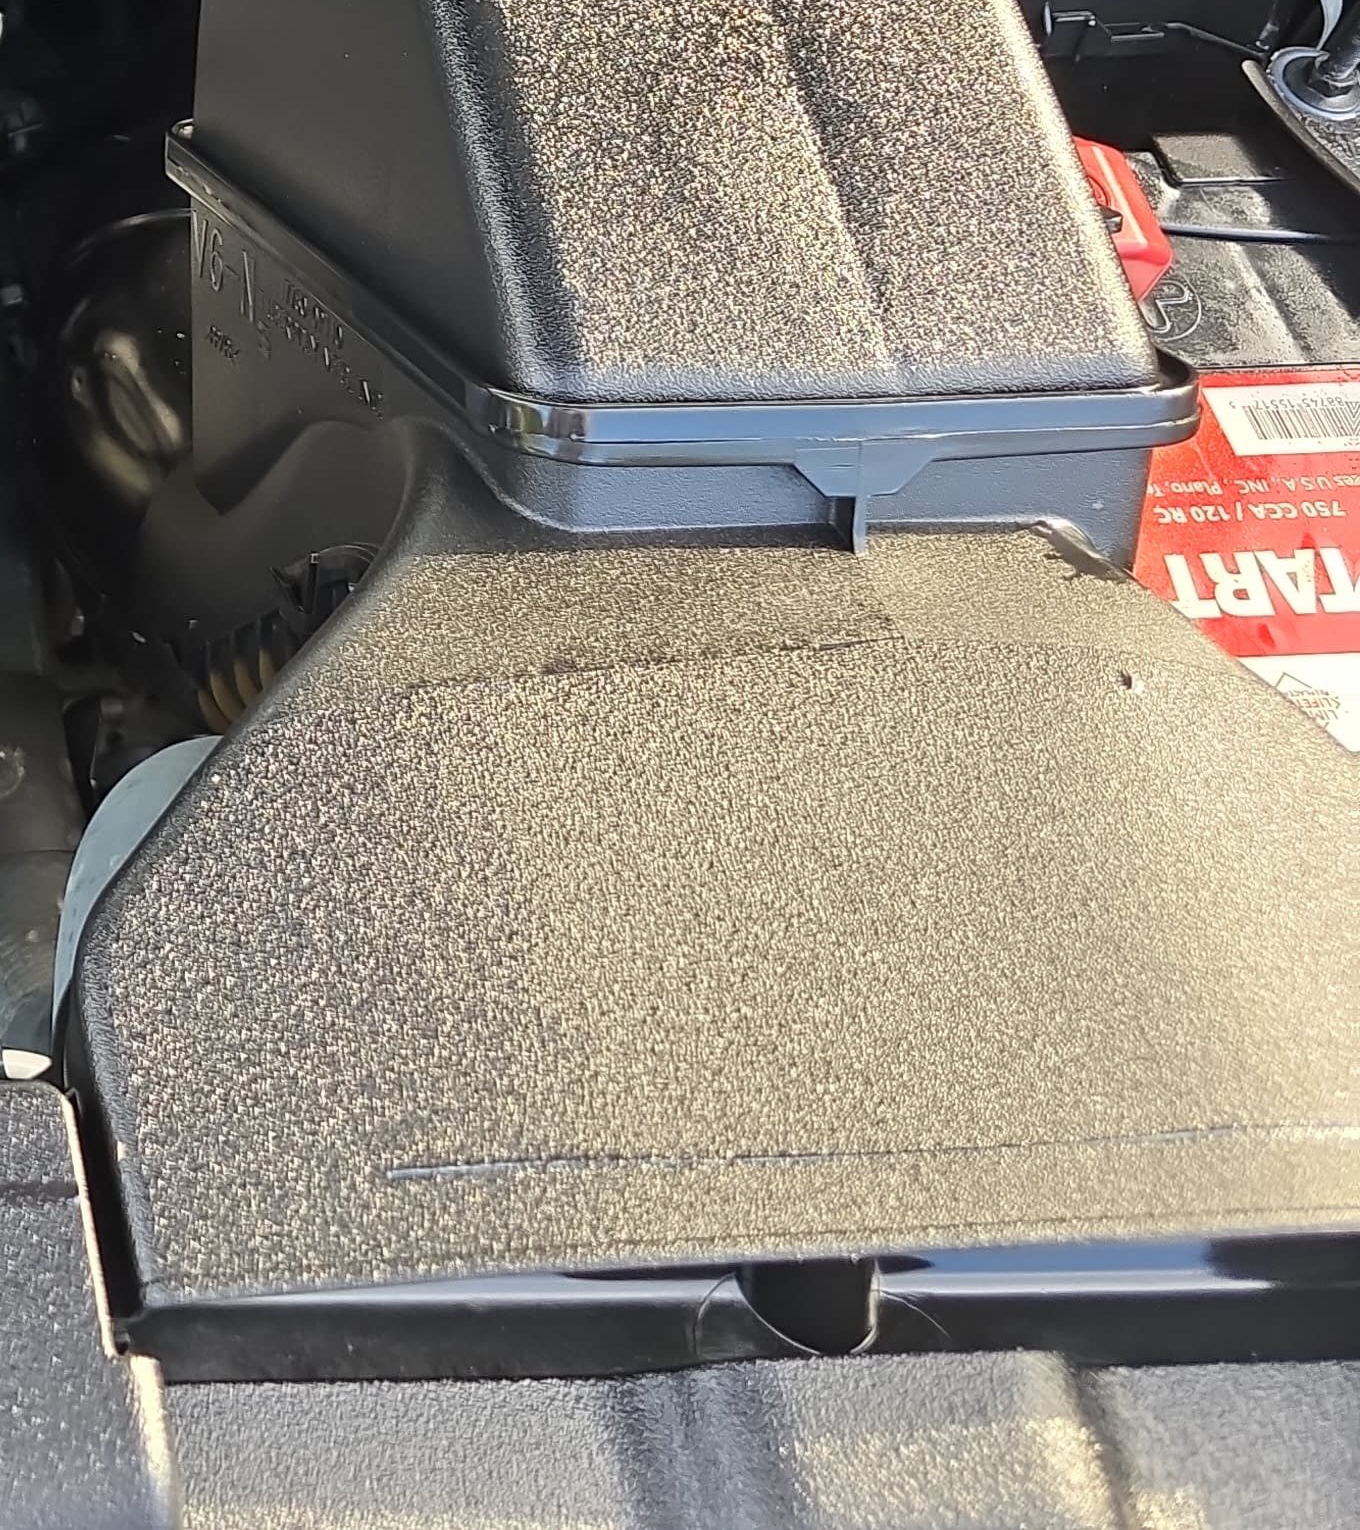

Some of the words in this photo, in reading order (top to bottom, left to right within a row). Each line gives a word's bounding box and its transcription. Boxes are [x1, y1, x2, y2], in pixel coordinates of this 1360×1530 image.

[1153, 505, 1188, 523] RC
[1190, 504, 1230, 521] 120
[1248, 502, 1298, 519] CCA
[1300, 501, 1346, 517] 750
